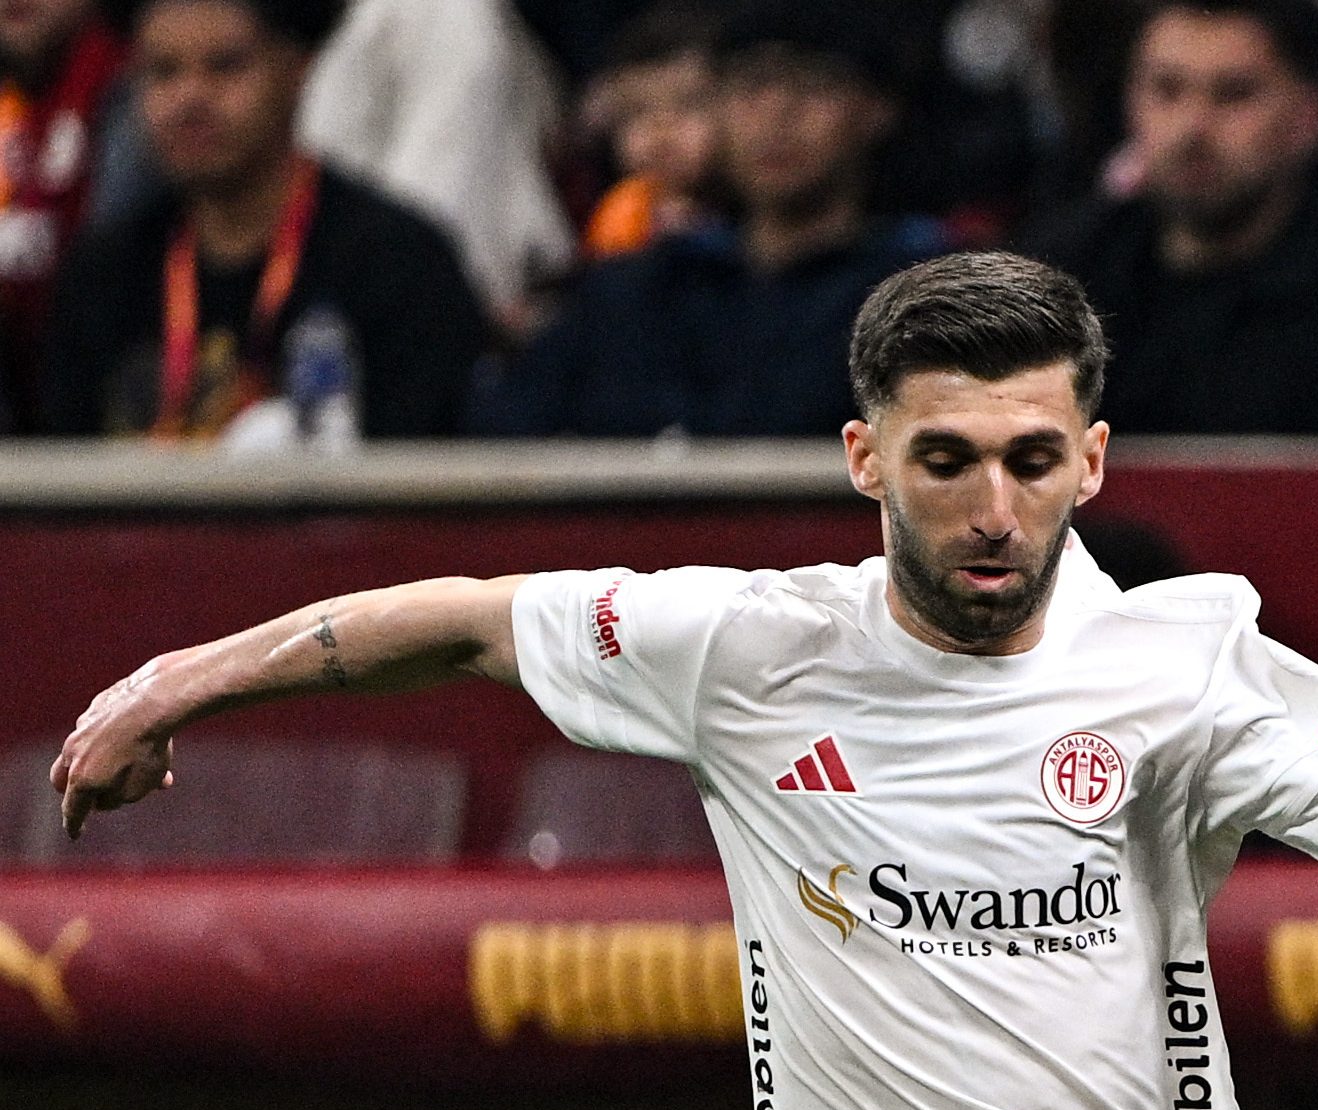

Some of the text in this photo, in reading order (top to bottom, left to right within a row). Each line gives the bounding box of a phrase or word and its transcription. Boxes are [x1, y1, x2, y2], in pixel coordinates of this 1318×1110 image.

[1048, 736, 1120, 773] ANTALYASPOR
[868, 861, 1122, 932] Swandor
[900, 926, 1118, 958] HOTELS & RESORTS
